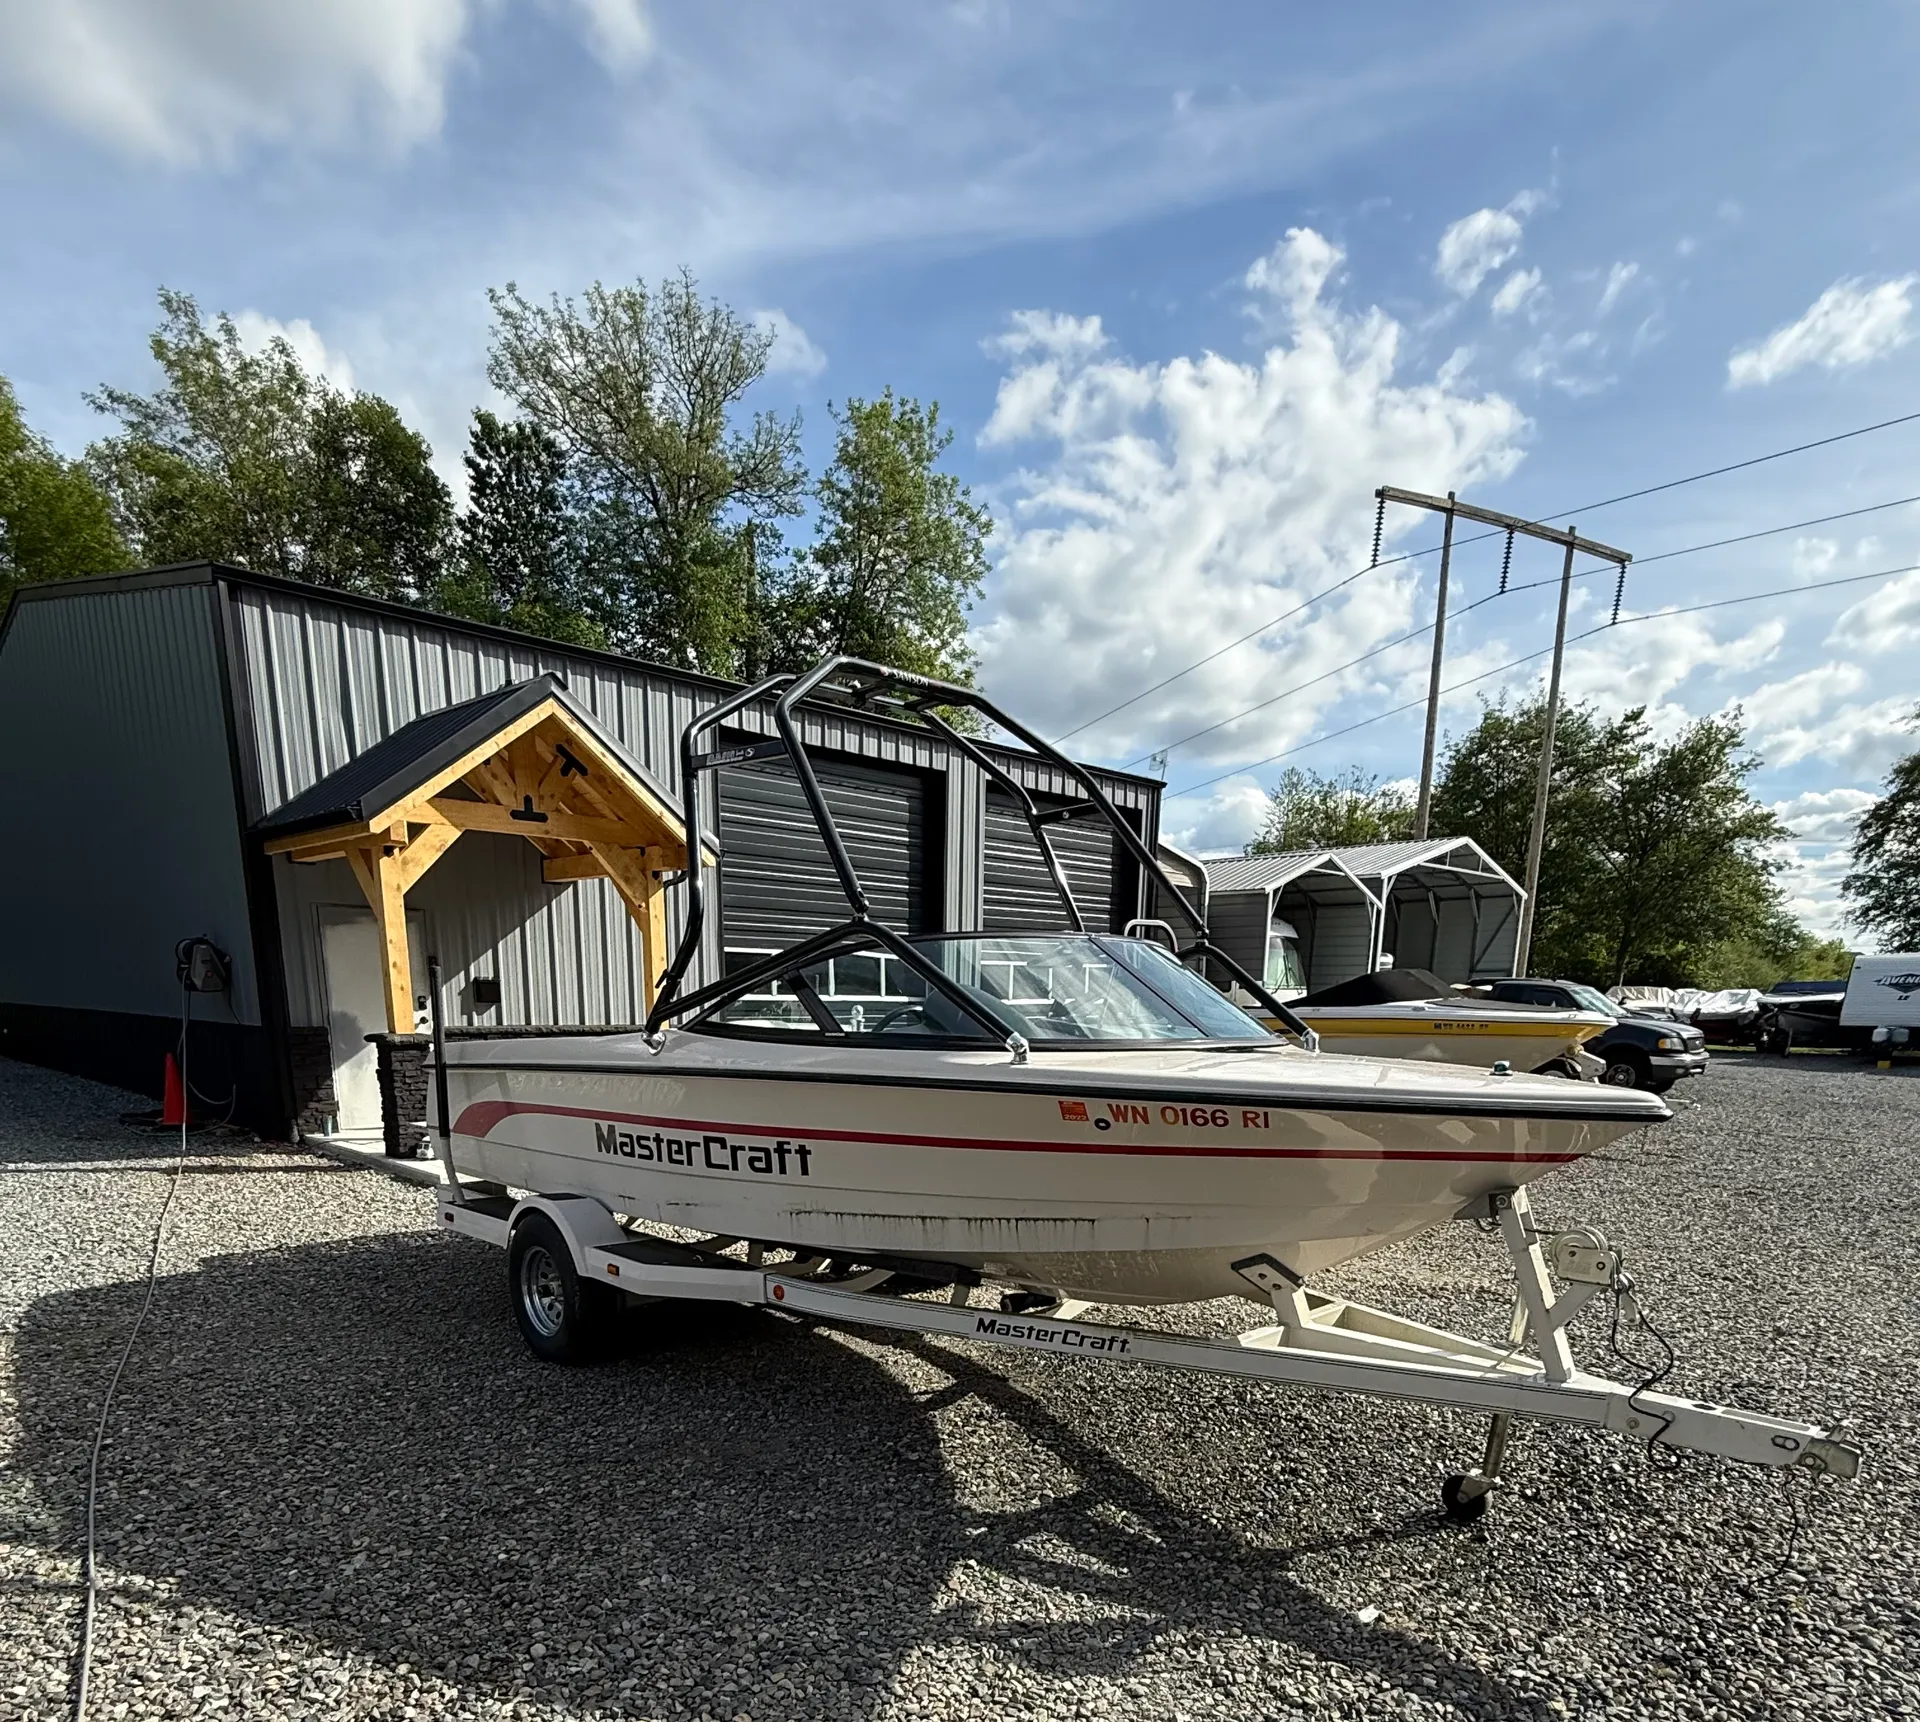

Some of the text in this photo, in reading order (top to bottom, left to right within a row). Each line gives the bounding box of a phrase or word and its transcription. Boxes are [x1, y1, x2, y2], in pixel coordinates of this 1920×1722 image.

[893, 669, 929, 687] SAMSON
[1107, 1103, 1270, 1129] WN 0166 RI
[594, 1122, 812, 1176] MasterCraft
[975, 1317, 1130, 1353] MasterCraft
